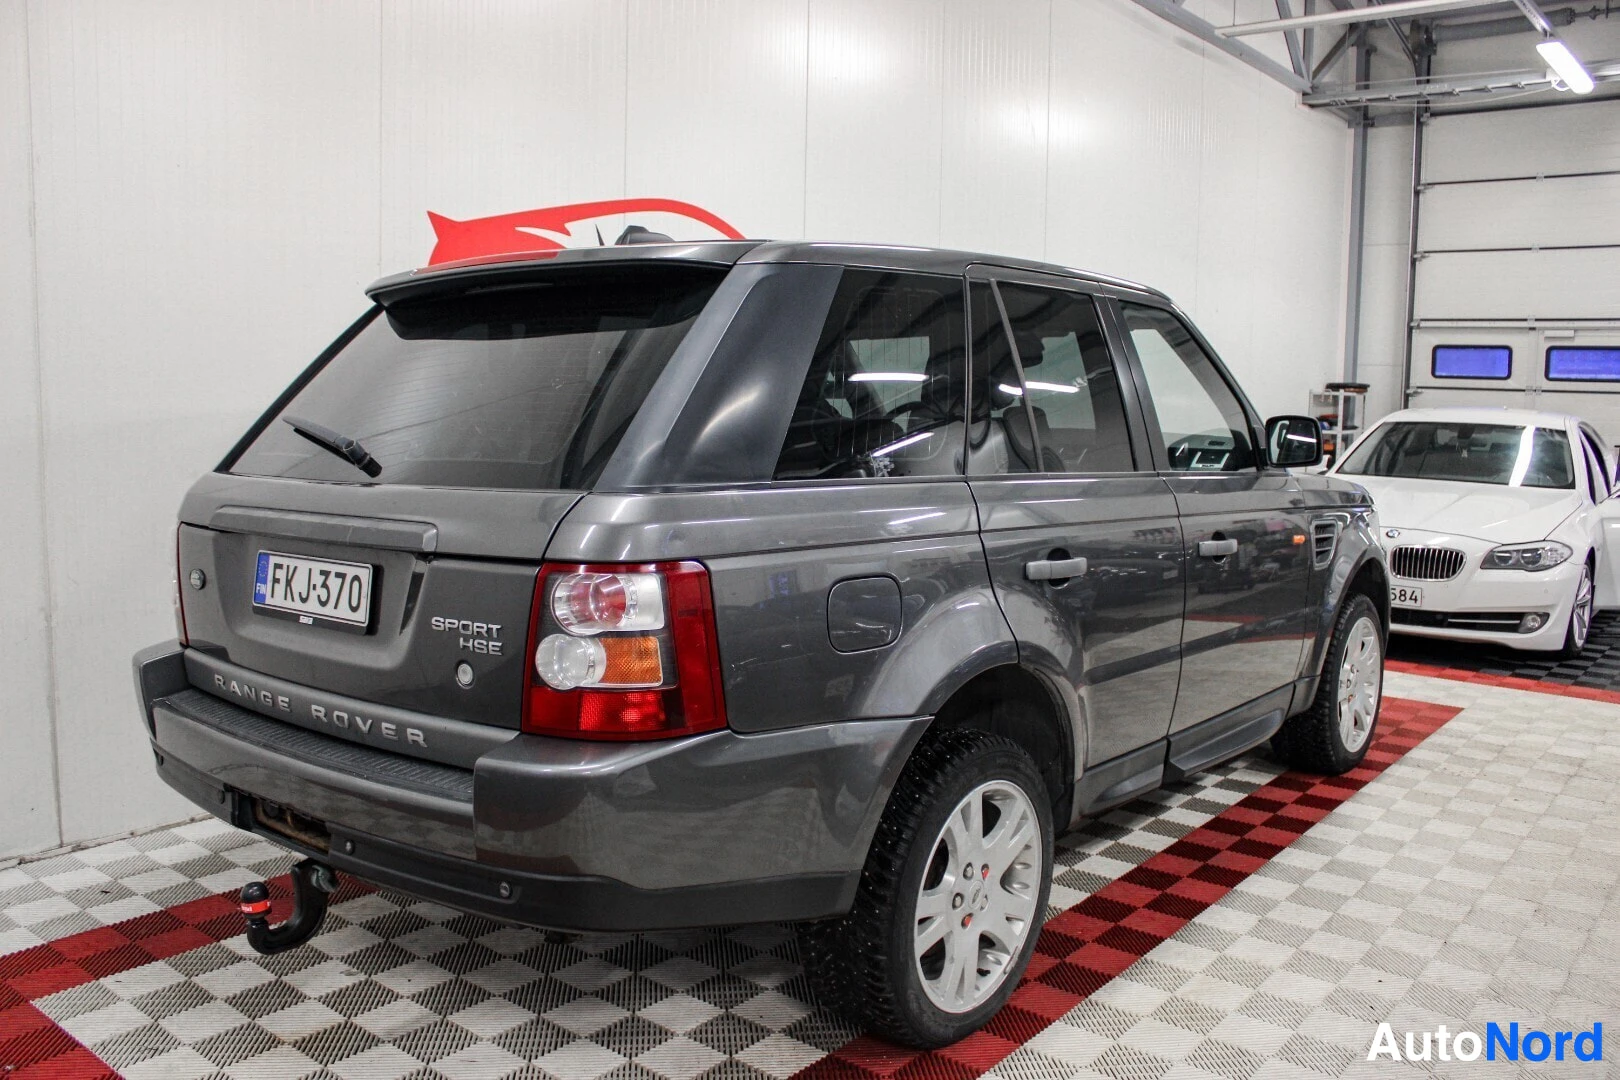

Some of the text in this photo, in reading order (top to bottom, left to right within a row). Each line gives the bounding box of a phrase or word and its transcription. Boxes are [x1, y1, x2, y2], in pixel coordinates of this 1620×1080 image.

[256, 582, 267, 594] FIN
[1391, 588, 1418, 604] 584
[431, 616, 502, 638] SPORT
[459, 637, 502, 656] HSE
[214, 673, 428, 748] RANGE ROVER
